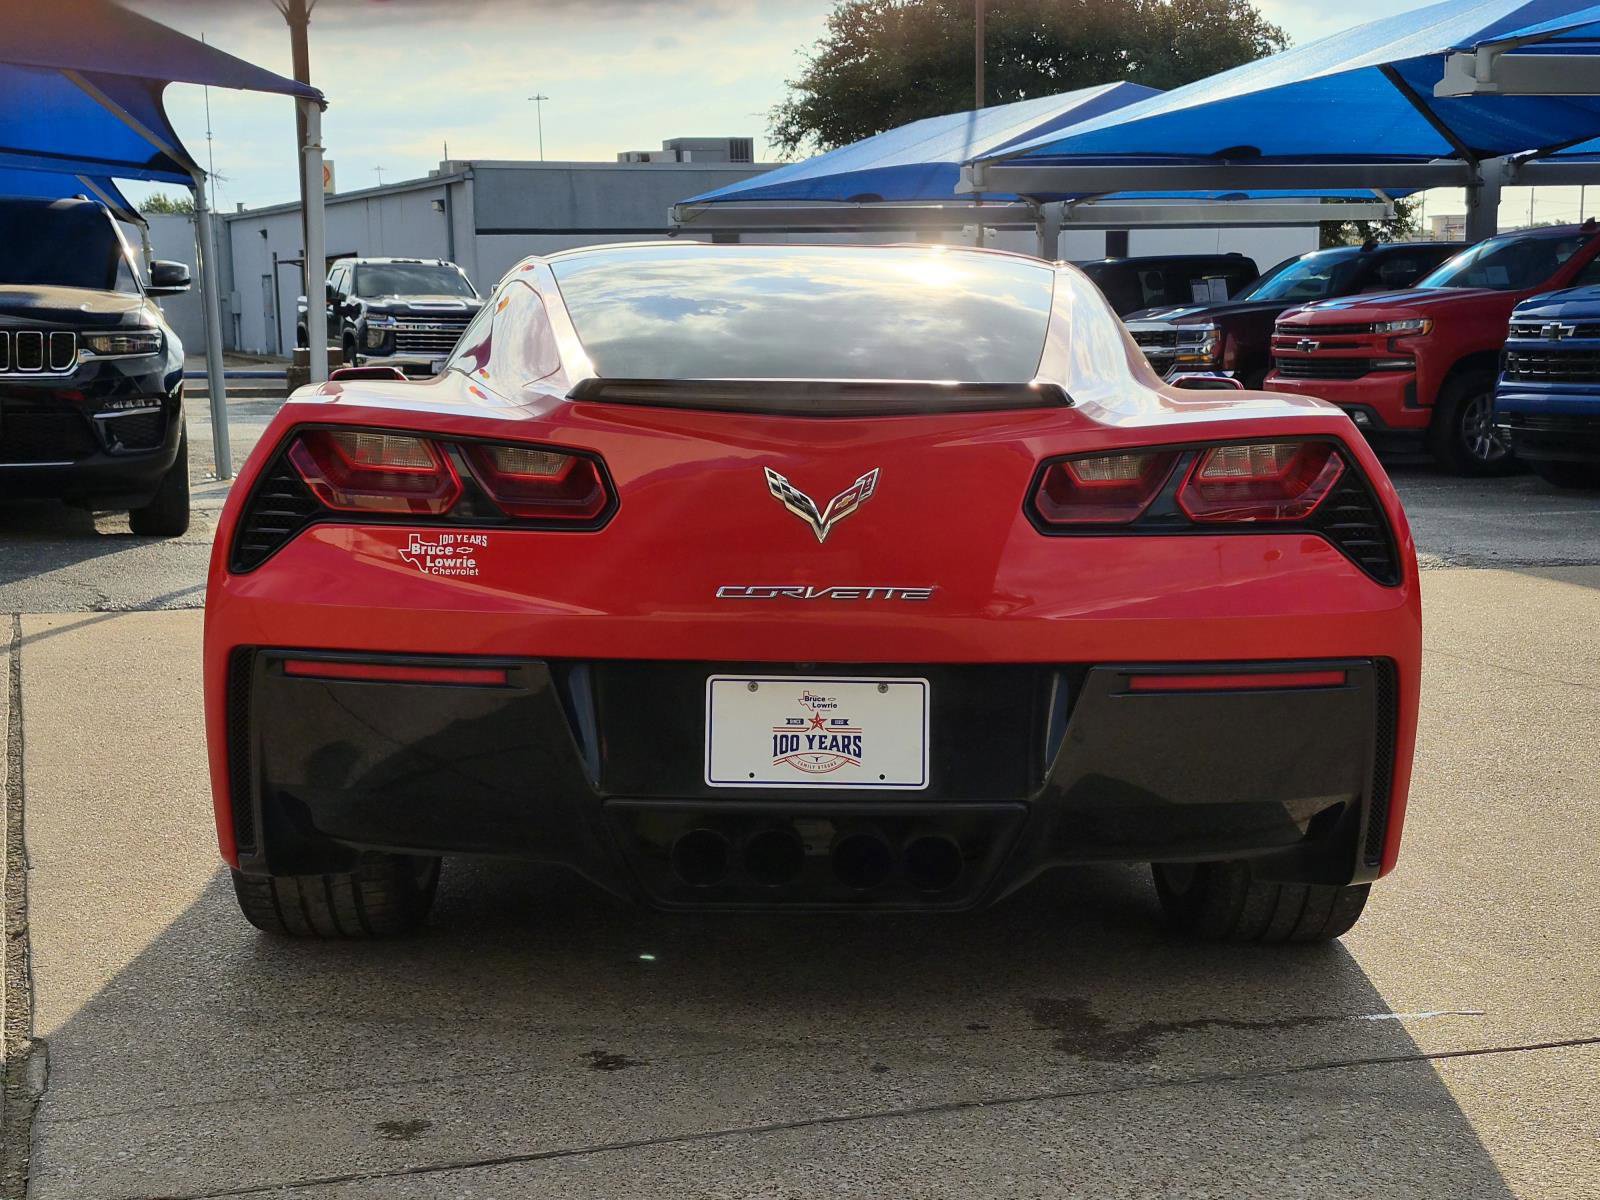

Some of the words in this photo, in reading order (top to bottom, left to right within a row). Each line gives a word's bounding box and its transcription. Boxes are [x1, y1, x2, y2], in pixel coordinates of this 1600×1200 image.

[439, 534, 454, 545] 100
[456, 534, 488, 547] YEARS
[411, 543, 454, 555] Bruce
[426, 555, 477, 568] Lowrie
[431, 567, 479, 576] Chevrolet
[716, 586, 933, 600] CORVETTE
[772, 734, 800, 758] 100
[804, 734, 862, 759] YEARS
